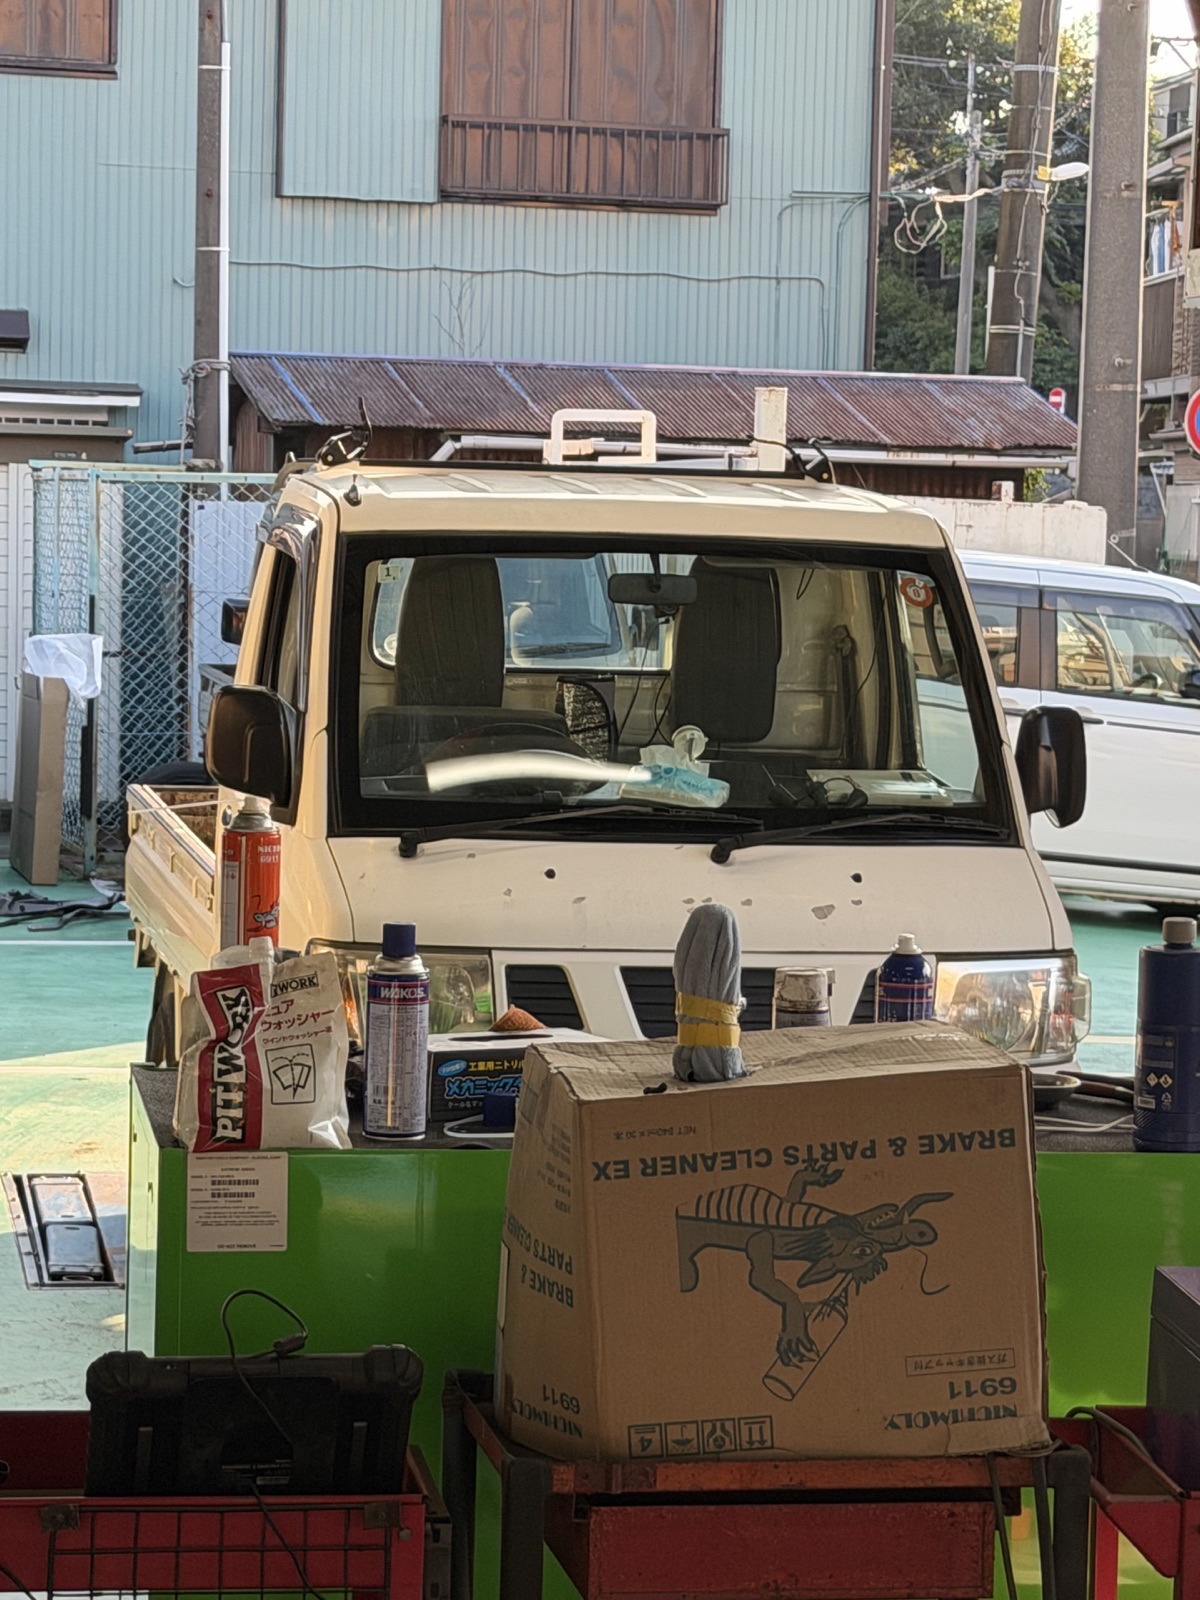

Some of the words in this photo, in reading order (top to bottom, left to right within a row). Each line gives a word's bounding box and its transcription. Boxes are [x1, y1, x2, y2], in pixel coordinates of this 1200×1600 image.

[216, 988, 251, 1079] WORK
[261, 1009, 335, 1032] ウォッシャー
[216, 1087, 244, 1140] PIT
[677, 1126, 696, 1136] NET
[918, 1128, 1017, 1154] BRAKE
[783, 1139, 877, 1167] PARTS
[887, 1138, 907, 1157] &
[592, 1160, 630, 1182] EX
[641, 1147, 773, 1177] CLEANER
[533, 1238, 573, 1275] PARTS
[529, 1270, 574, 1308] BRAKE
[542, 1384, 580, 1415] 6911
[948, 1377, 1018, 1397] 6911
[511, 1398, 583, 1439] NICHIMOLY
[884, 1404, 1018, 1430] NICHIMOLY
